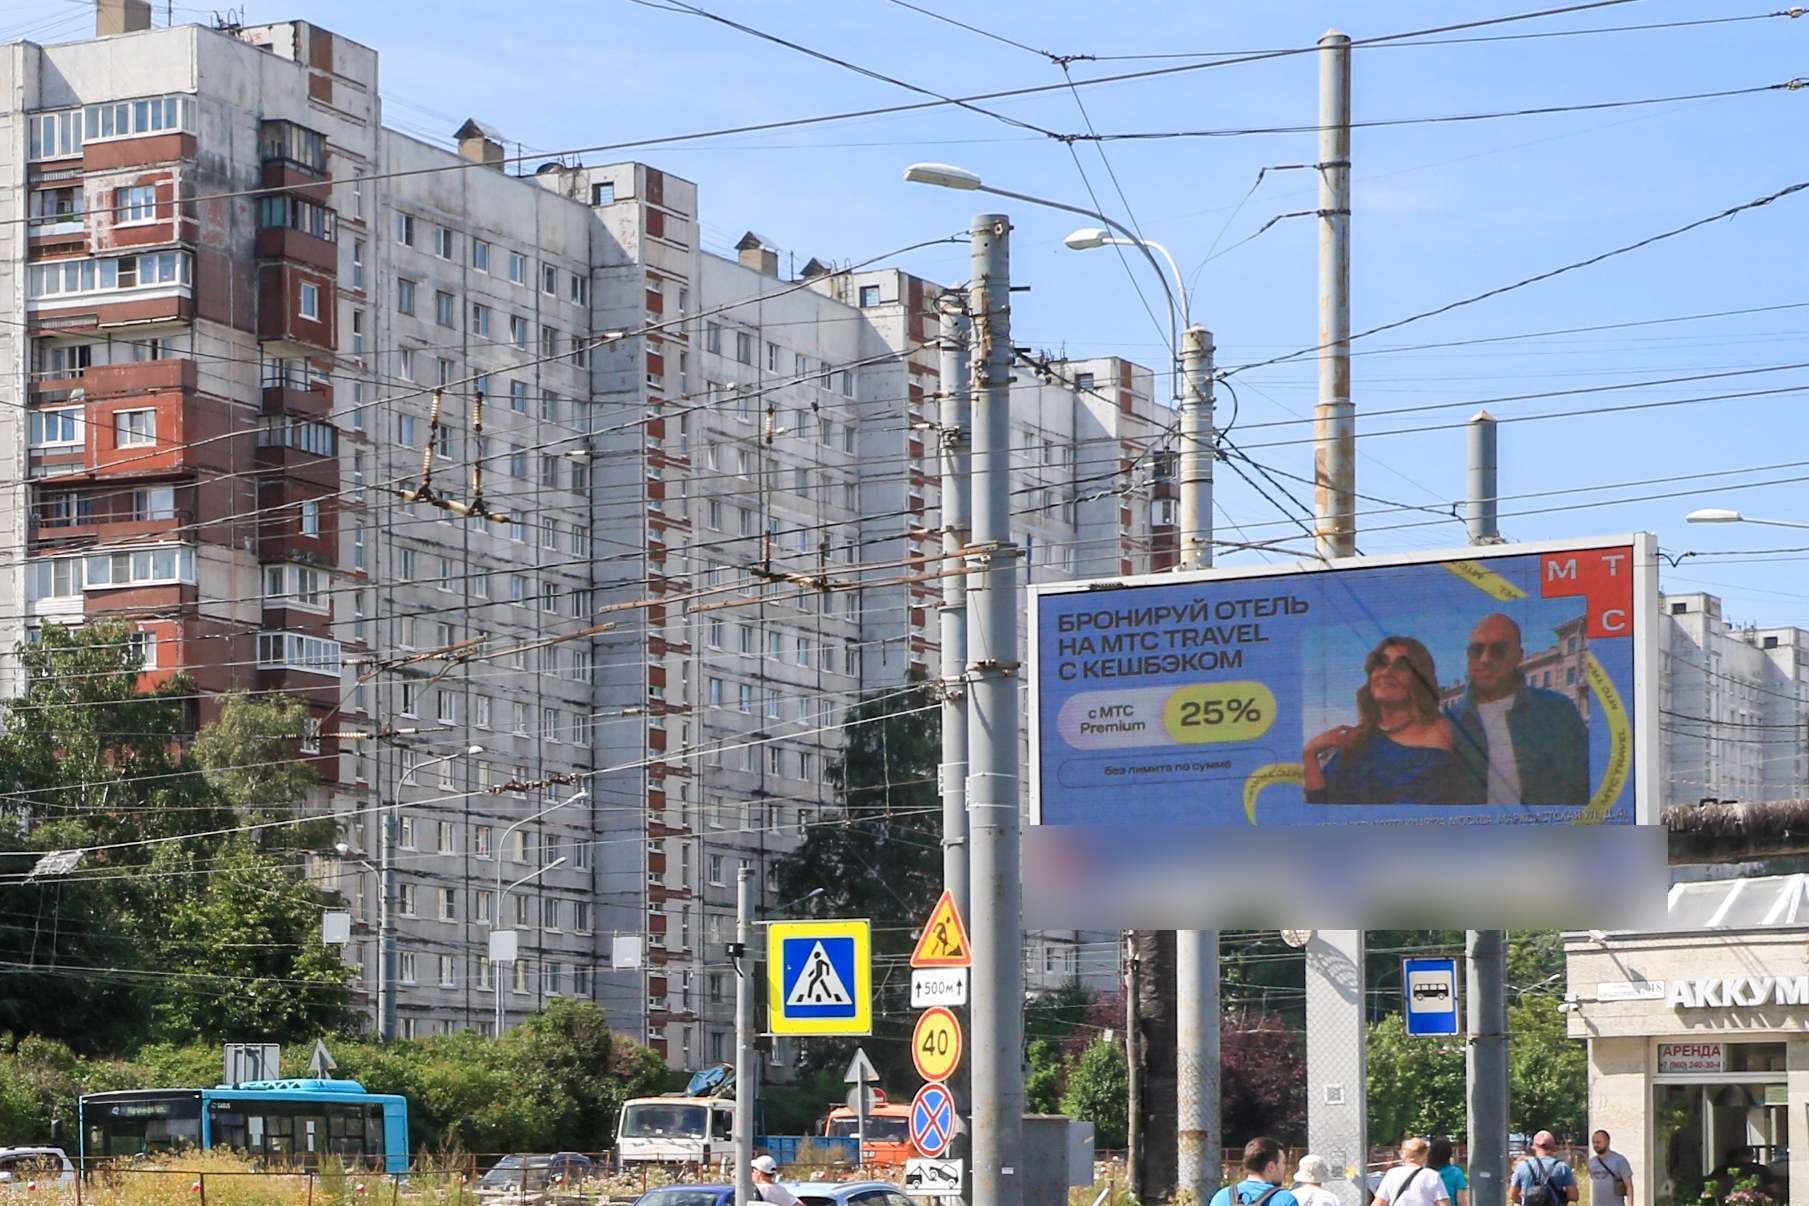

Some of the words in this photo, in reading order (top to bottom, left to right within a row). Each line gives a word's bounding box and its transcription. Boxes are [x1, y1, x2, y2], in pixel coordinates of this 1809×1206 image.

[1058, 599, 1209, 632] БРОНИРУЙ
[1215, 596, 1310, 620] ОТЕЛЬ
[1058, 637, 1097, 656] НА
[1101, 632, 1160, 653] МТС
[1164, 624, 1269, 648] TRAVEL
[1058, 661, 1077, 681] С
[1082, 650, 1243, 679] КЕШБЭКОМ
[1100, 704, 1134, 718] МТС
[1180, 698, 1261, 727] 25%
[1080, 720, 1146, 734] Premium
[1104, 765, 1127, 776] без
[1128, 763, 1172, 776] лимита
[1174, 763, 1190, 773] по
[1191, 760, 1232, 773] сумме
[921, 1028, 948, 1056] 40
[1662, 1045, 1721, 1059] АРЕНДА
